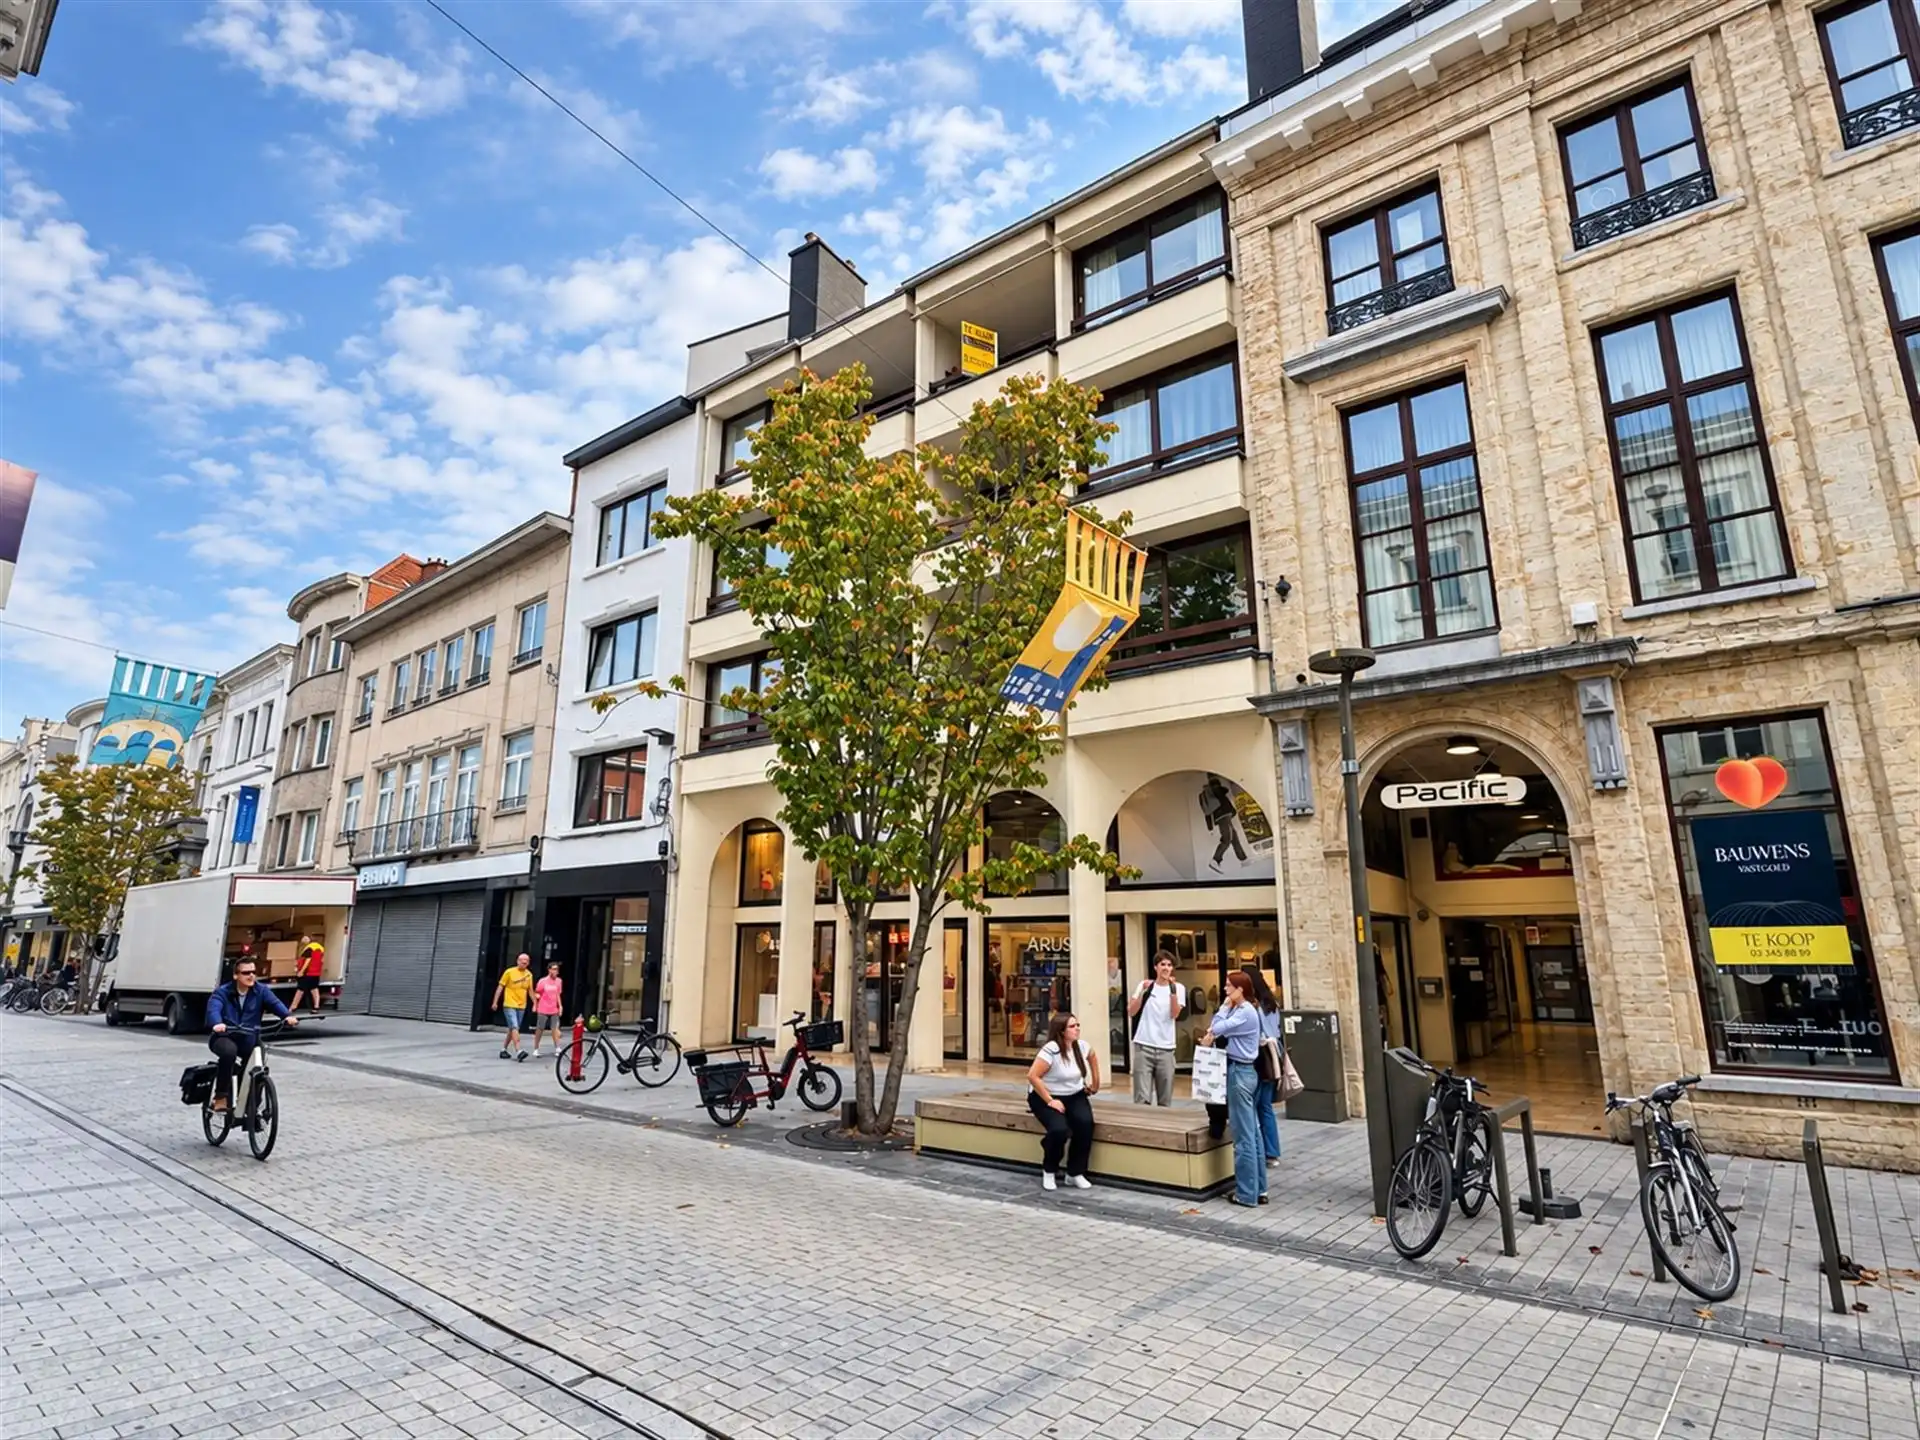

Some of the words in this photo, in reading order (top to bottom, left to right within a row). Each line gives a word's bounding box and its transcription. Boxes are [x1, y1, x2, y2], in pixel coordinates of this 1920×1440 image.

[1396, 779, 1508, 804] Pacific
[1714, 842, 1811, 863] BAUWENS
[1741, 932, 1762, 947] TE
[1766, 932, 1815, 947] KOOP
[1750, 948, 1762, 958] 03
[1765, 948, 1782, 958] 345
